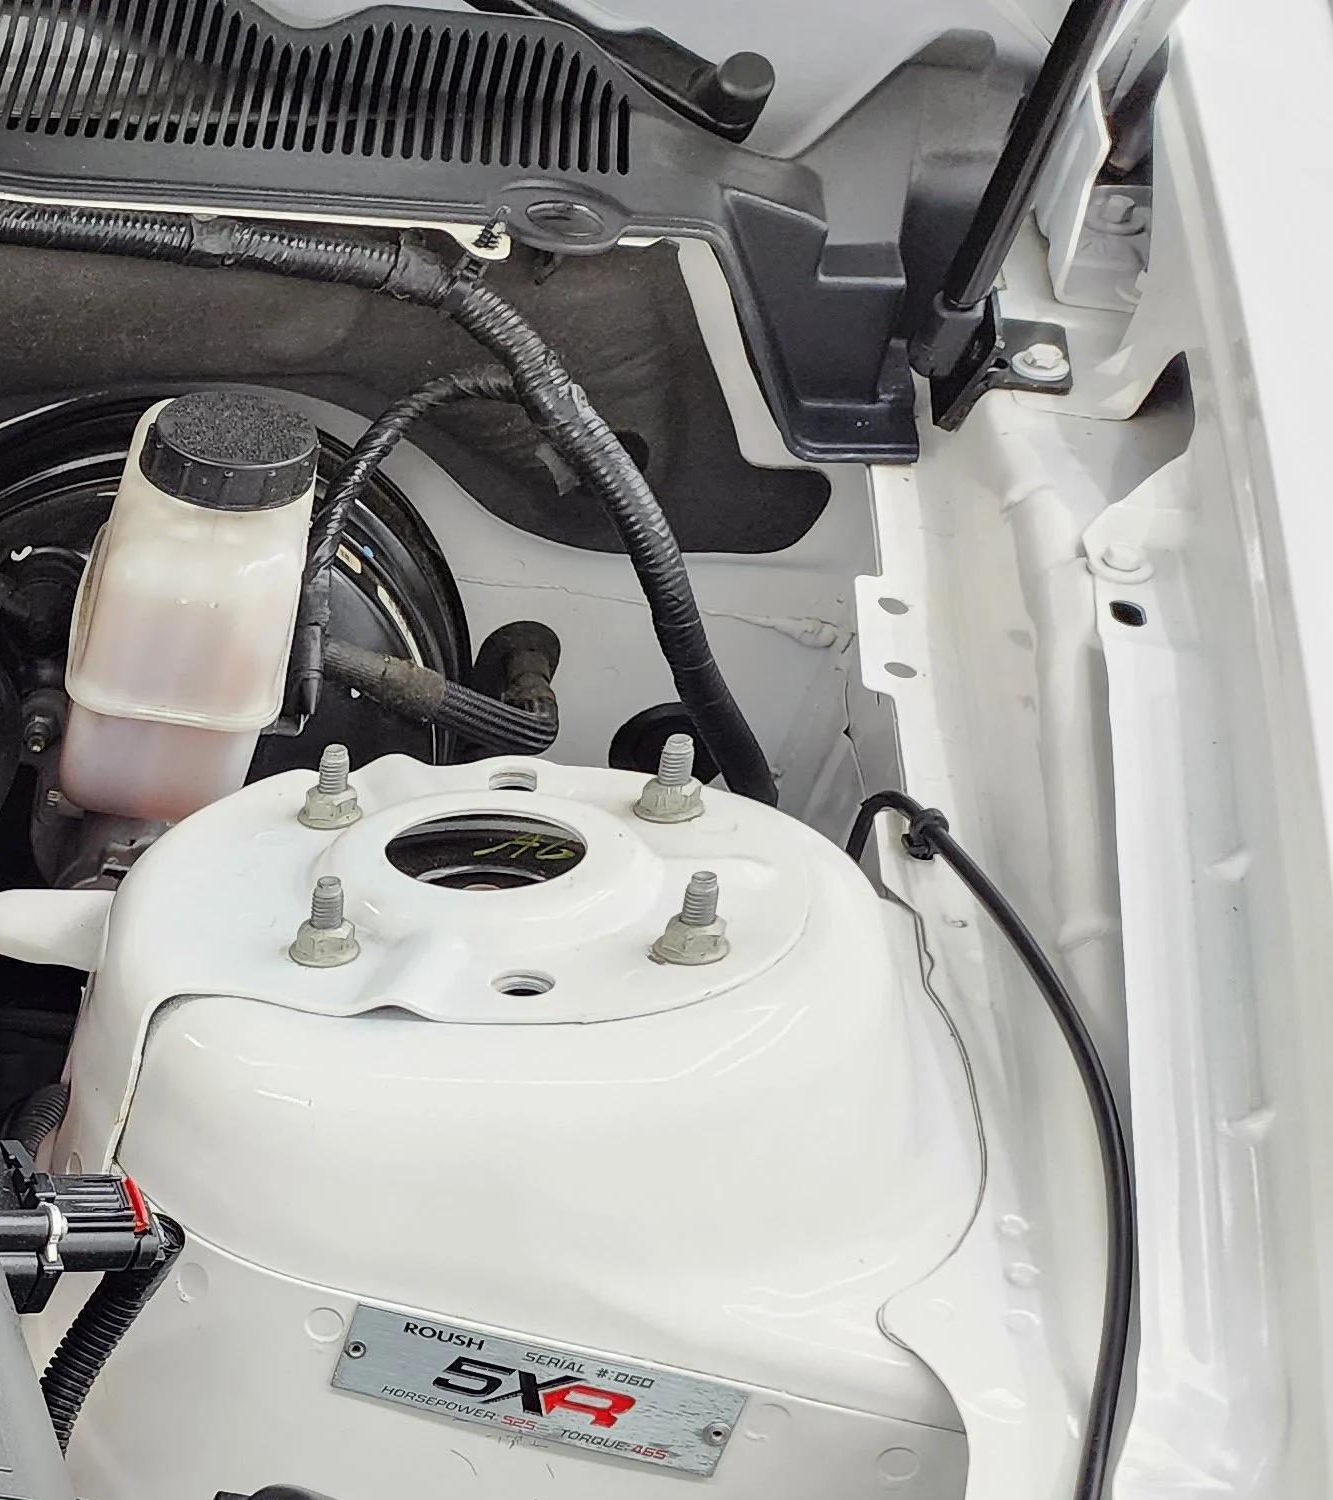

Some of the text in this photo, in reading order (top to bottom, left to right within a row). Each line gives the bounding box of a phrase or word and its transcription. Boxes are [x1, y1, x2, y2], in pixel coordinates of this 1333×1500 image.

[403, 1321, 485, 1351] ROUSH
[521, 1351, 586, 1374] SERIAL
[432, 1355, 636, 1429] 5XR
